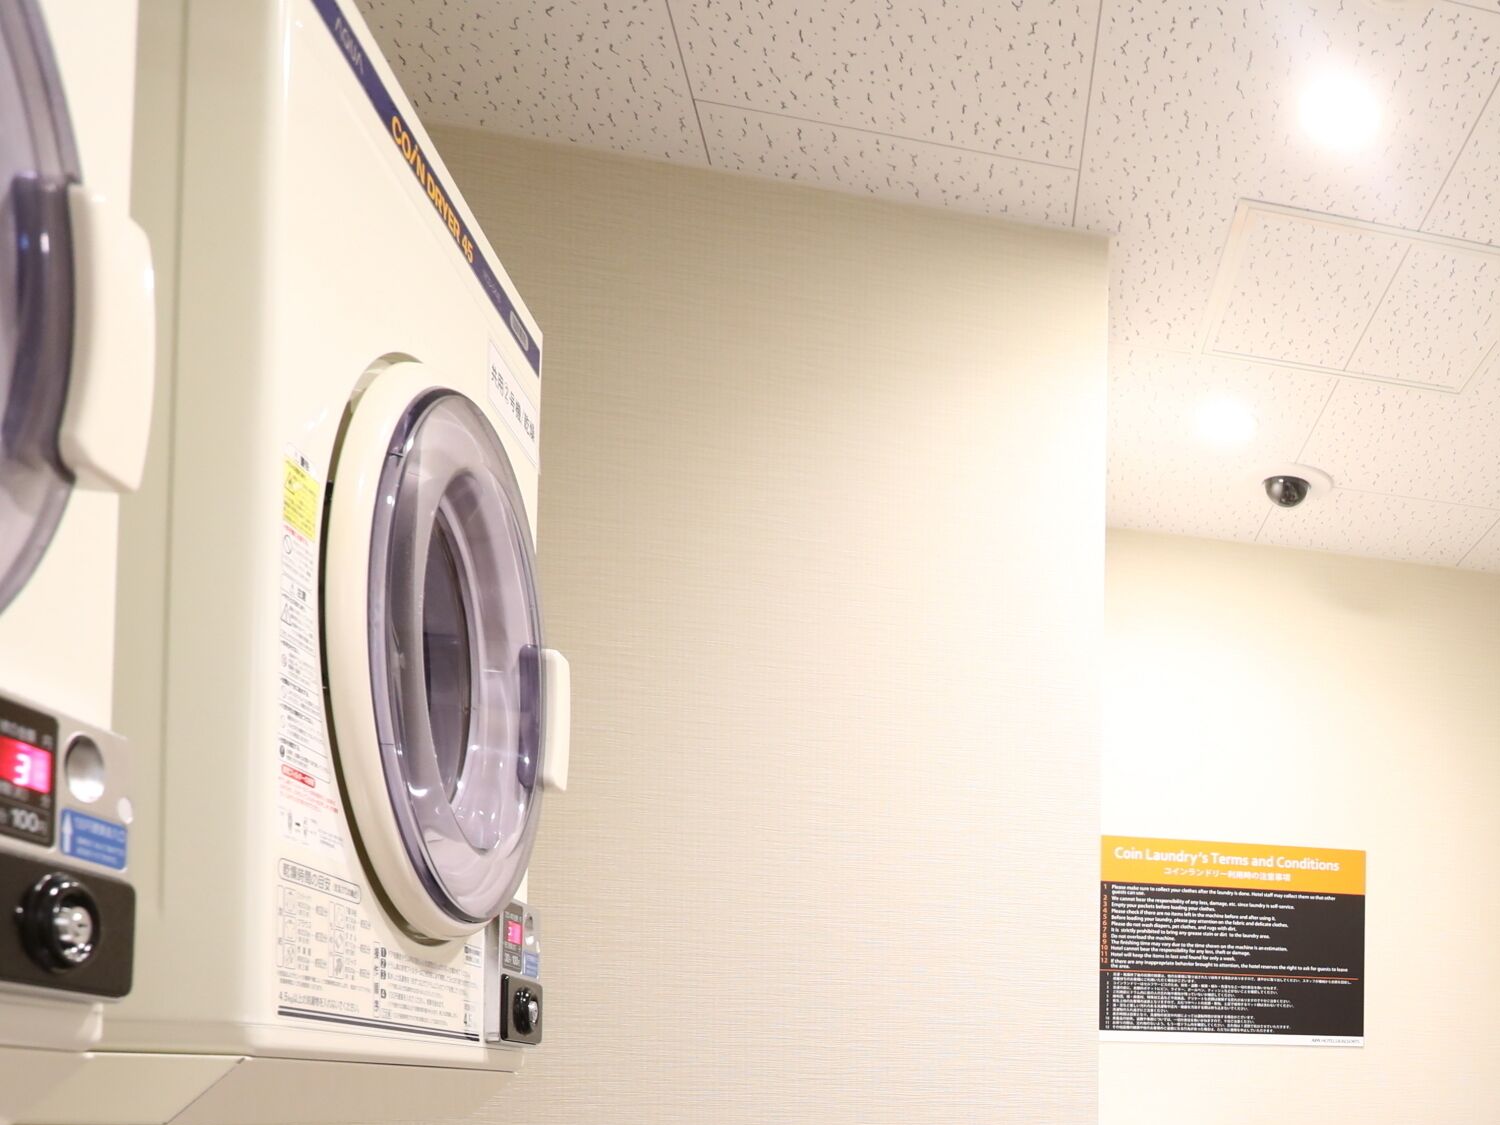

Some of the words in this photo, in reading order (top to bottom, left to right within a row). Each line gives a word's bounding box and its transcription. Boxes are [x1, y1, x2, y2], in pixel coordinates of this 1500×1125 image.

[426, 172, 461, 242] DRYER
[461, 234, 474, 264] 45
[13, 752, 31, 786] 3
[1114, 847, 1142, 861] Coin
[1211, 852, 1248, 868] Terms
[1251, 856, 1274, 869] and
[1276, 858, 1340, 873] Conditions
